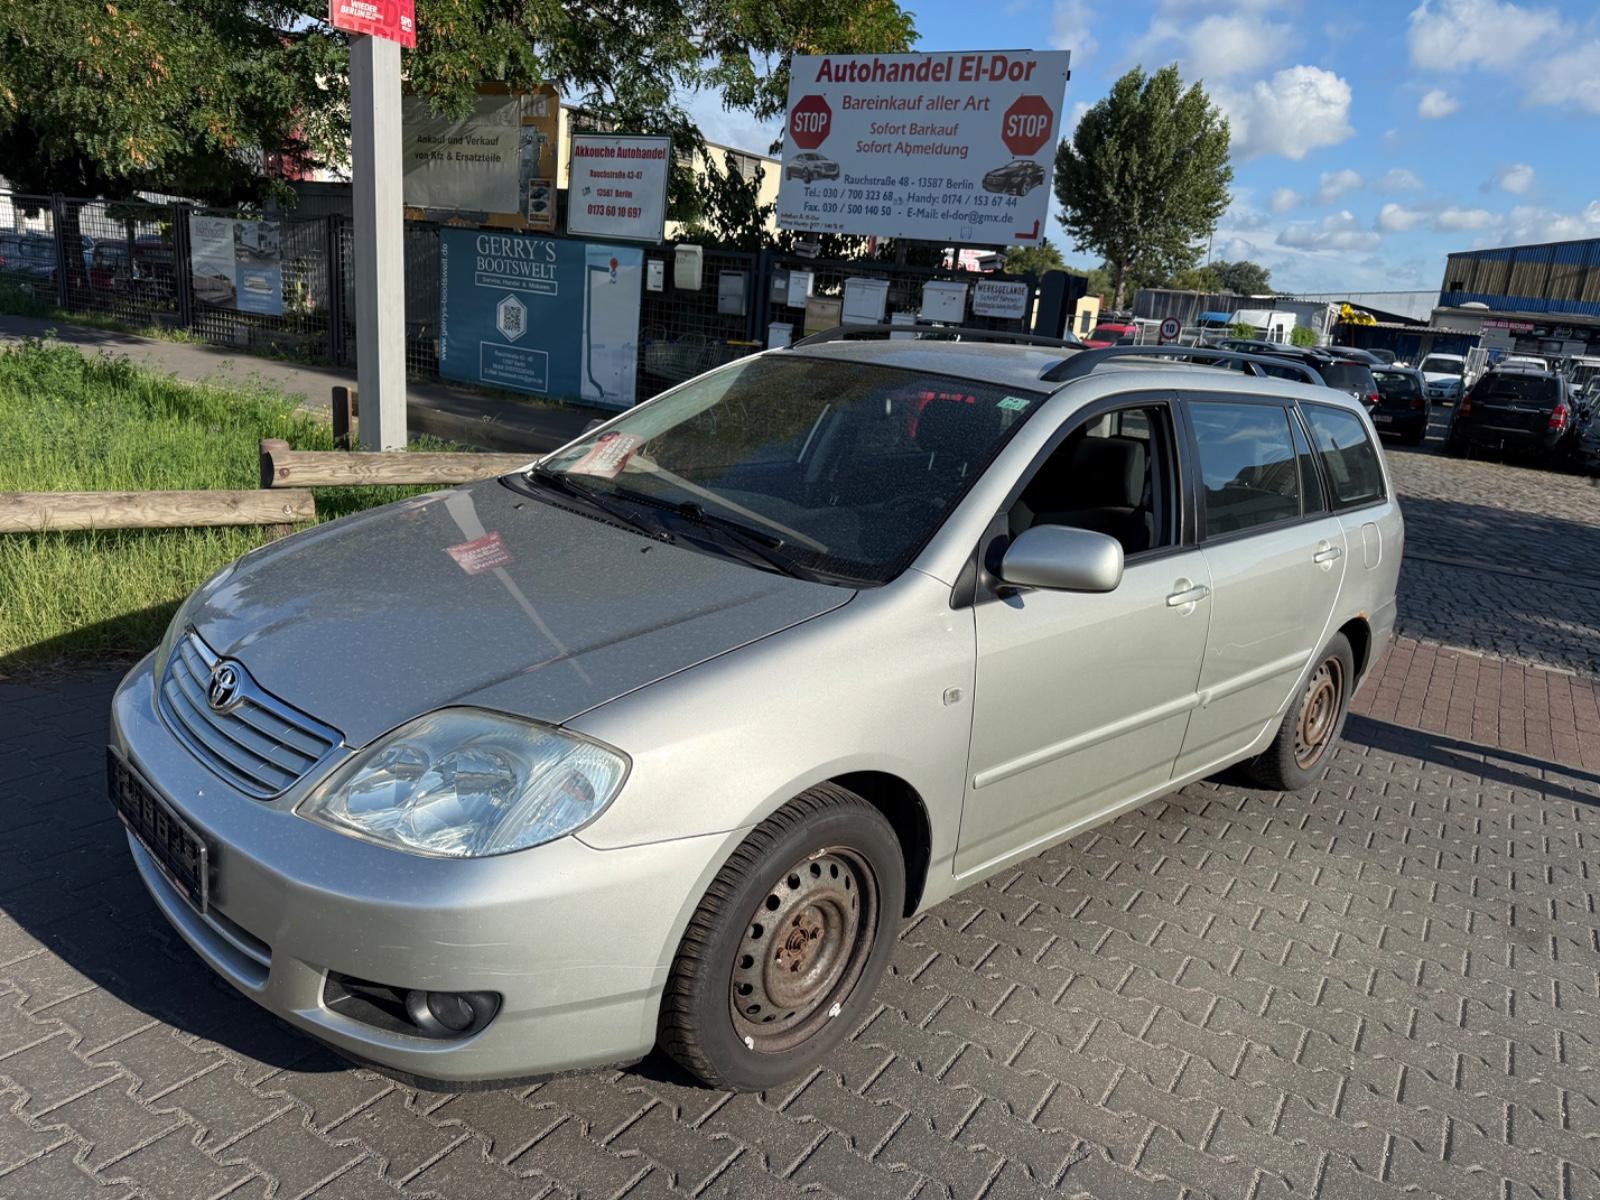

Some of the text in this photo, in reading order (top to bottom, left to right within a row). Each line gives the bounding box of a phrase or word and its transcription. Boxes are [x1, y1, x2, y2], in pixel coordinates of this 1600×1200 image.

[340, 5, 366, 18] BERLIN
[352, 0, 378, 12] WIEDER
[400, 16, 413, 27] SPD
[815, 55, 1037, 82] Autohandel El-Dor
[842, 95, 990, 111] Bareinkauf aller Art
[794, 112, 827, 133] STOP
[869, 122, 960, 137] Sofort Barkauf
[1007, 114, 1047, 137] STOP
[417, 135, 500, 146] Ankauf und Verkauf
[415, 151, 502, 163] von Kfz & Ersatzteile
[575, 146, 666, 160] Akkouche Autohandel
[856, 141, 968, 159] Sofort Abmeldung
[844, 174, 896, 187] Rauchstraße
[899, 176, 909, 187] 48
[918, 176, 944, 188] 13587
[947, 178, 974, 190] Berlin
[614, 189, 633, 199] Berlin
[822, 188, 838, 199] 030
[848, 189, 863, 200] 700
[865, 189, 880, 200] 323
[882, 190, 893, 201] 68
[907, 192, 940, 206] Handy:
[941, 194, 962, 206] 0174
[973, 195, 990, 207] 153
[992, 196, 1003, 207] 67
[1005, 197, 1017, 208] 44
[587, 204, 642, 219] 0173 60 10 697
[804, 201, 820, 212] Fax.
[822, 203, 838, 214] 030
[848, 204, 863, 215] 500
[865, 204, 879, 215] 140
[880, 205, 892, 216] 50
[907, 207, 939, 220] E-Mail:
[940, 210, 1014, 225] el-dor@gmx.de
[476, 256, 557, 279] BOOTSWELT
[1165, 323, 1175, 333] 10
